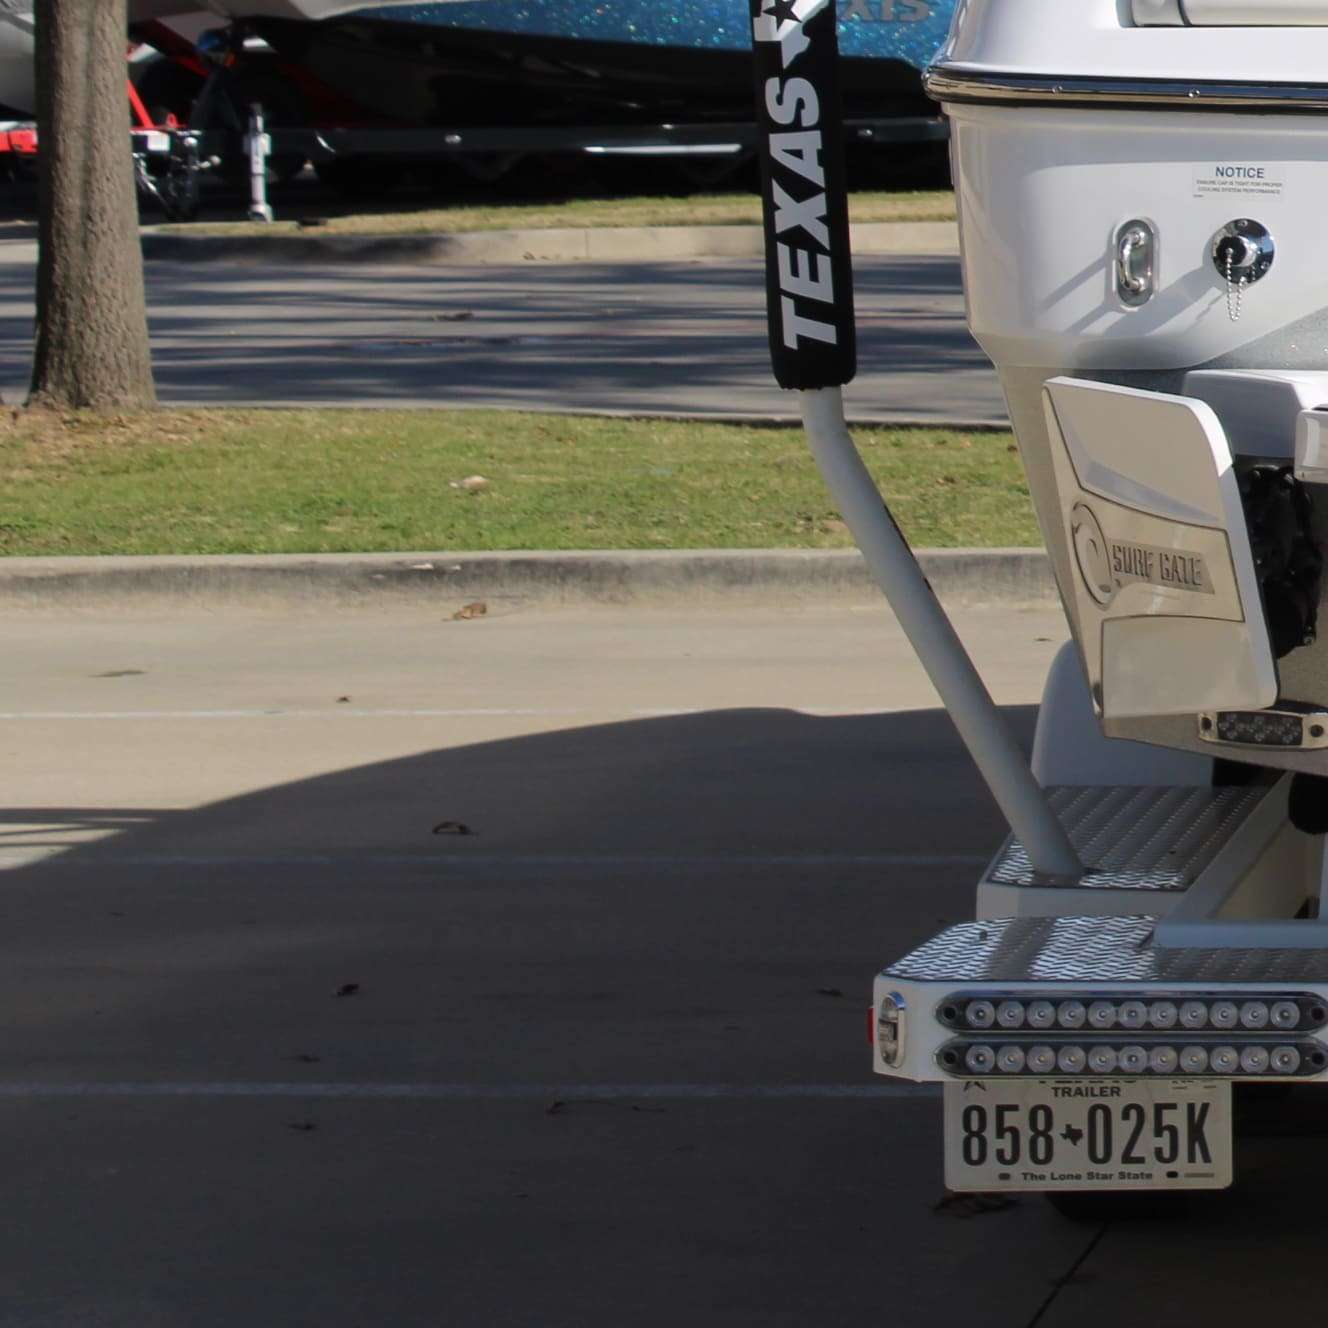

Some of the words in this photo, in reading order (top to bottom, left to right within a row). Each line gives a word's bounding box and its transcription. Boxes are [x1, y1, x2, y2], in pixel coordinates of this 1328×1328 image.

[1215, 166, 1265, 179] NOTICE
[764, 76, 837, 350] TEXAS
[1112, 544, 1153, 579] SURF
[1159, 552, 1204, 587] GATE
[1051, 1085, 1121, 1098] TRAILER
[961, 1103, 1054, 1167] 858
[1086, 1101, 1213, 1165] 025K
[1021, 1171, 1046, 1181] The
[1050, 1171, 1082, 1181] Lone
[1086, 1171, 1114, 1181] Star
[1118, 1170, 1153, 1181] State
